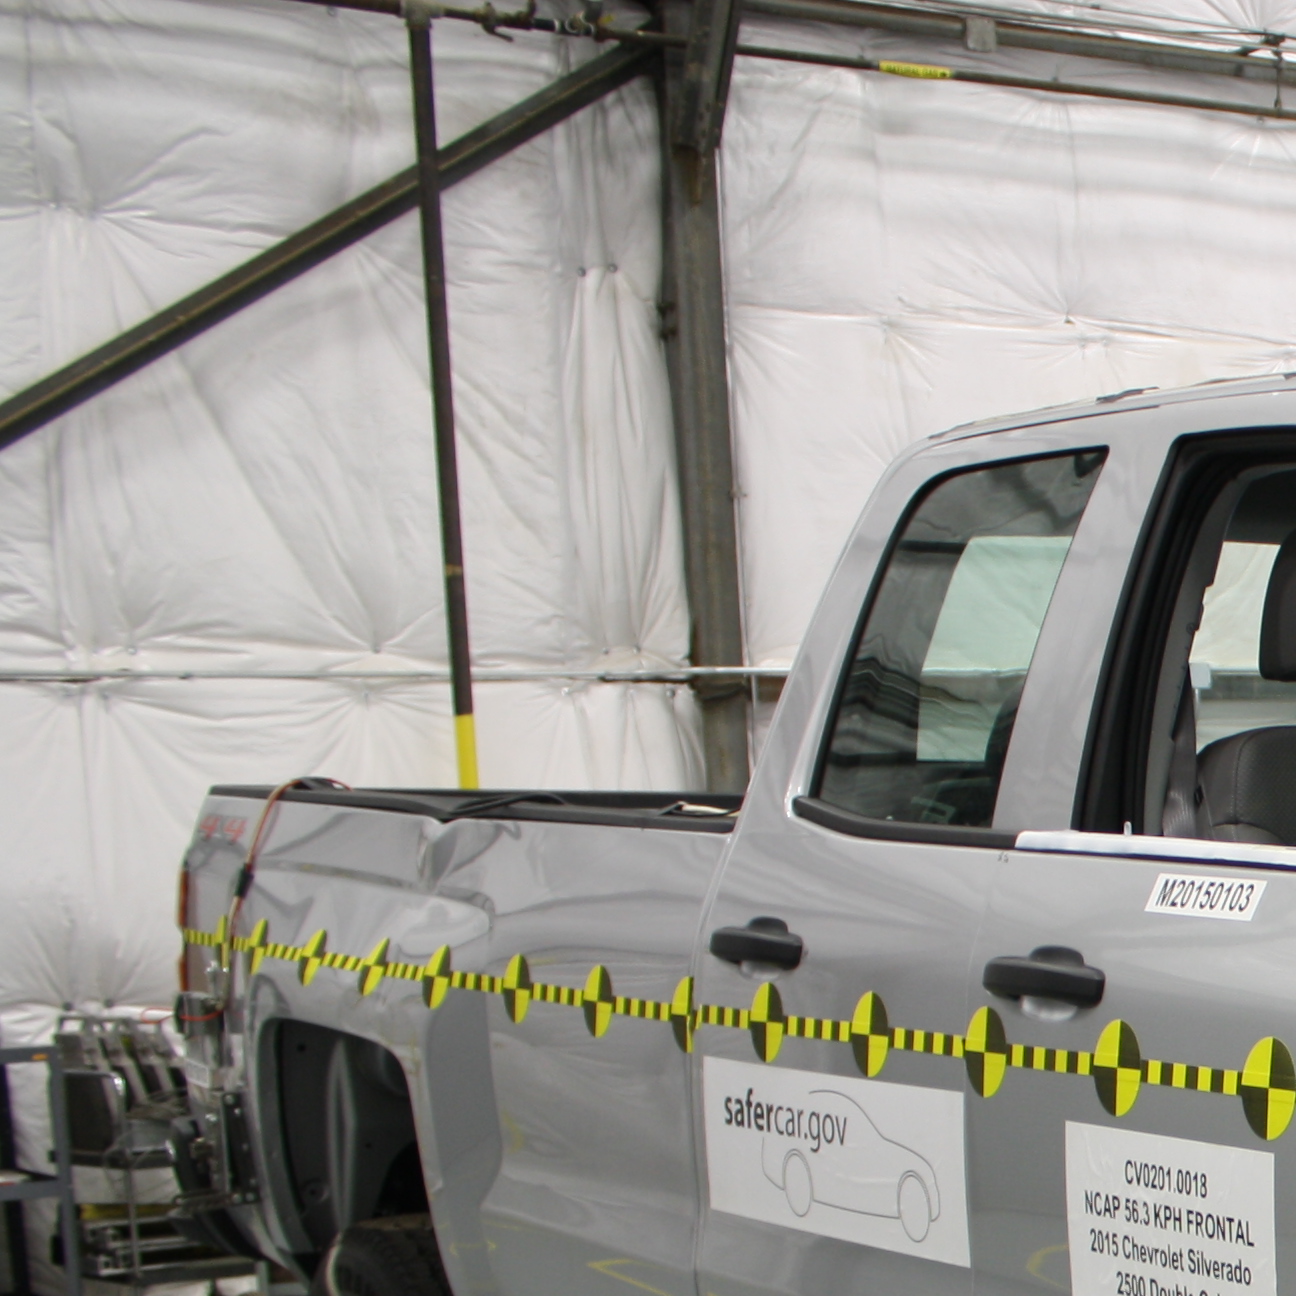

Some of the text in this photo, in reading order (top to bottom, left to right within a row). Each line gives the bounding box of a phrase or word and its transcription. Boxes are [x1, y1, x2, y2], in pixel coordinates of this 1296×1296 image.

[1155, 878, 1255, 912] M20150103
[724, 1087, 847, 1153] safercar.gov
[1124, 1160, 1208, 1198] CV0201.0018
[1084, 1190, 1255, 1247] NCAP 56.3 KPH FRONTAL
[1089, 1228, 1252, 1286] 2015 Chevrolet Silverado
